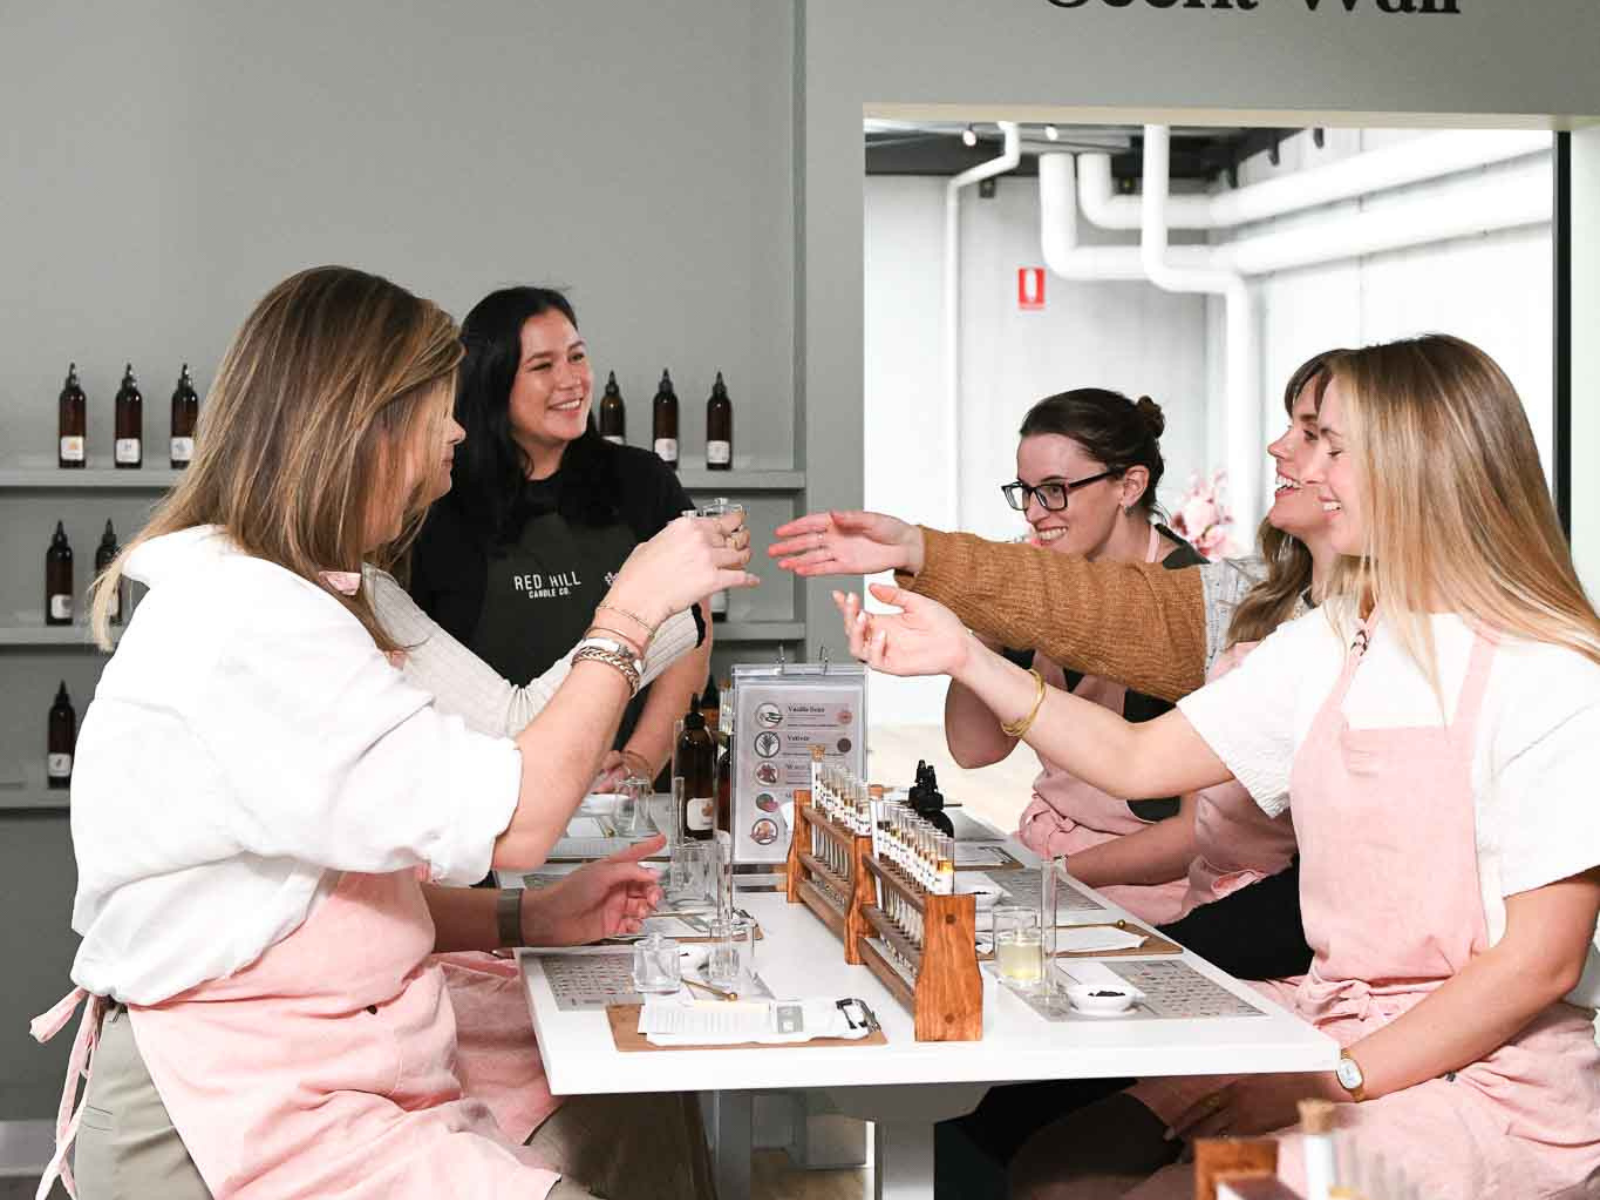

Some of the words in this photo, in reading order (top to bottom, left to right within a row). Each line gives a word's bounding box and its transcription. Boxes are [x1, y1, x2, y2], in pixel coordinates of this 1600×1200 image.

[514, 574, 542, 590] RED
[548, 571, 581, 587] HILL
[528, 588, 556, 599] CANDLE
